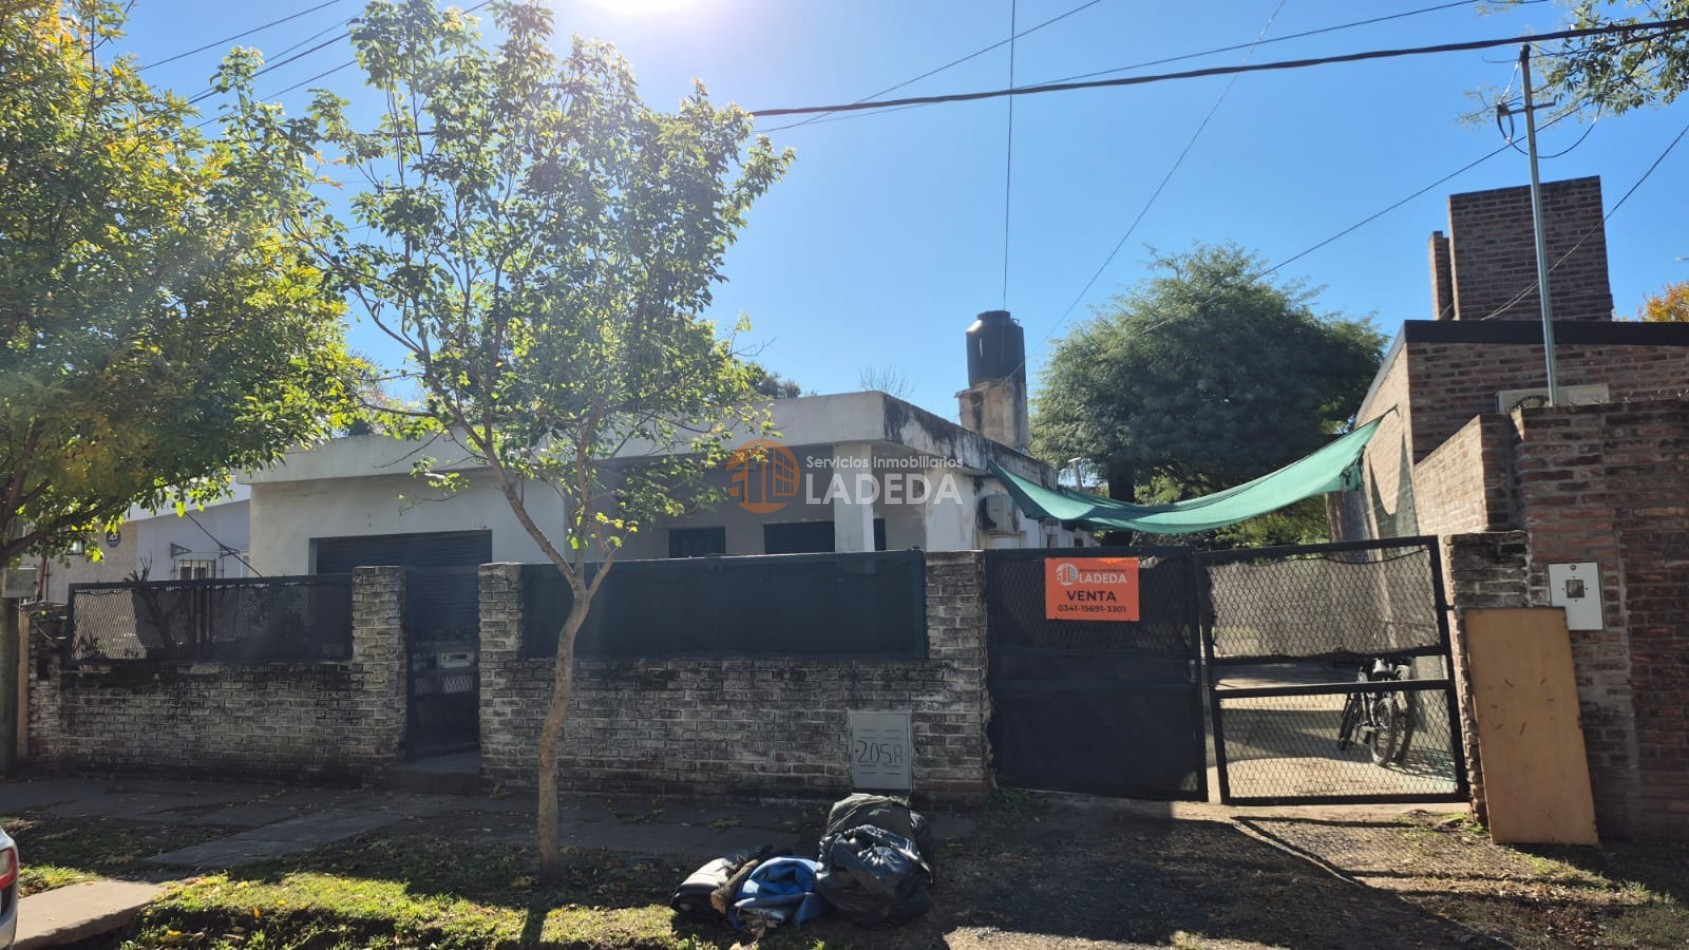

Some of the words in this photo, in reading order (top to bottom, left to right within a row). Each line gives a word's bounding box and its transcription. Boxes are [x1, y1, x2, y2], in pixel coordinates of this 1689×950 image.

[1079, 573, 1127, 584] LADEDA
[1066, 590, 1117, 602] VENTA
[856, 740, 903, 766] 2058
